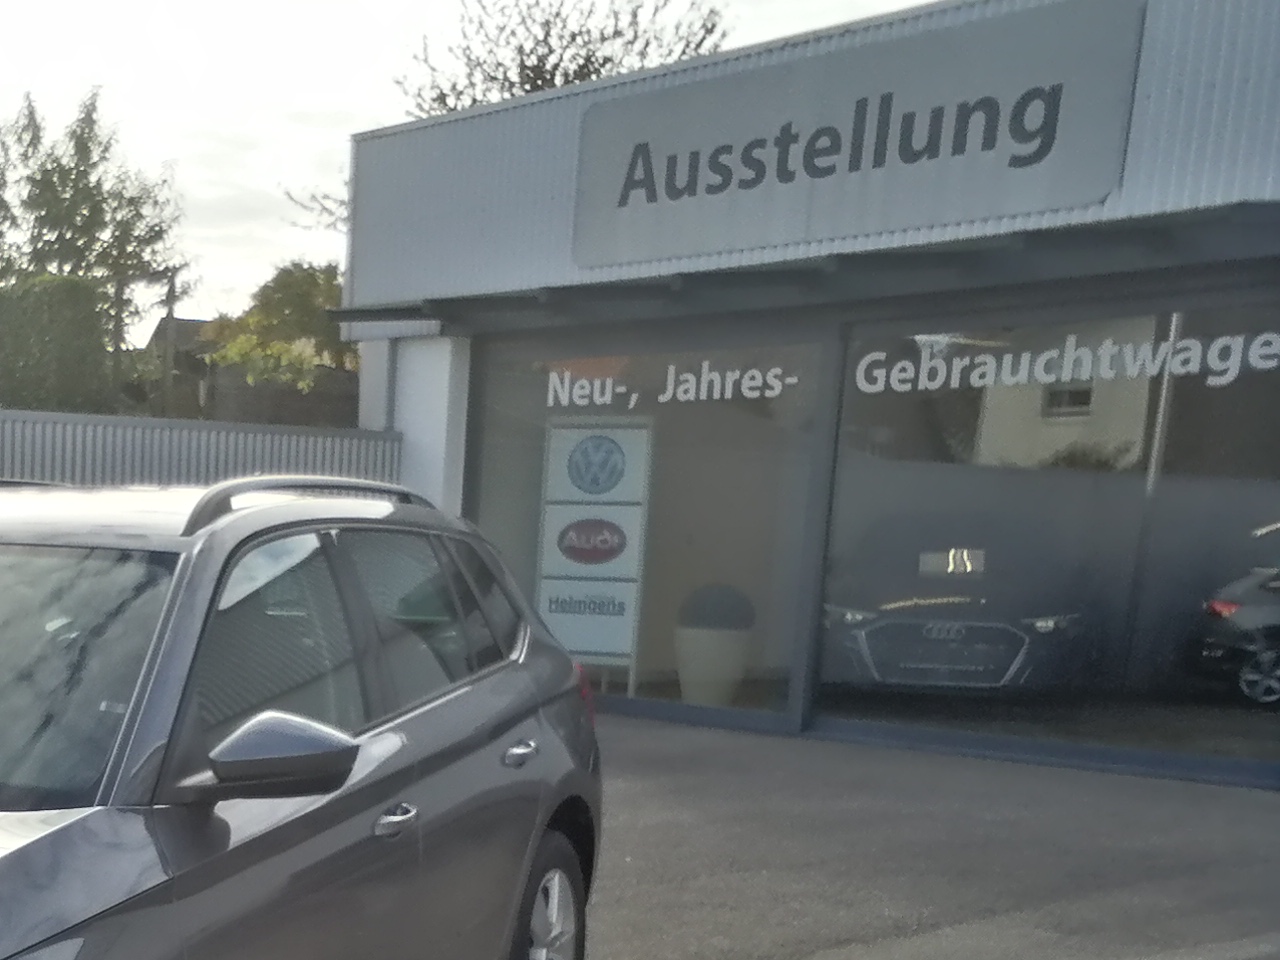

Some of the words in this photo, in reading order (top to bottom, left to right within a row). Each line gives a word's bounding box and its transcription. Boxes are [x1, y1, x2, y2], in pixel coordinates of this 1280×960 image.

[619, 83, 1064, 207] Ausstellung
[547, 368, 639, 409] Neu-,
[658, 360, 798, 403] Jahres-
